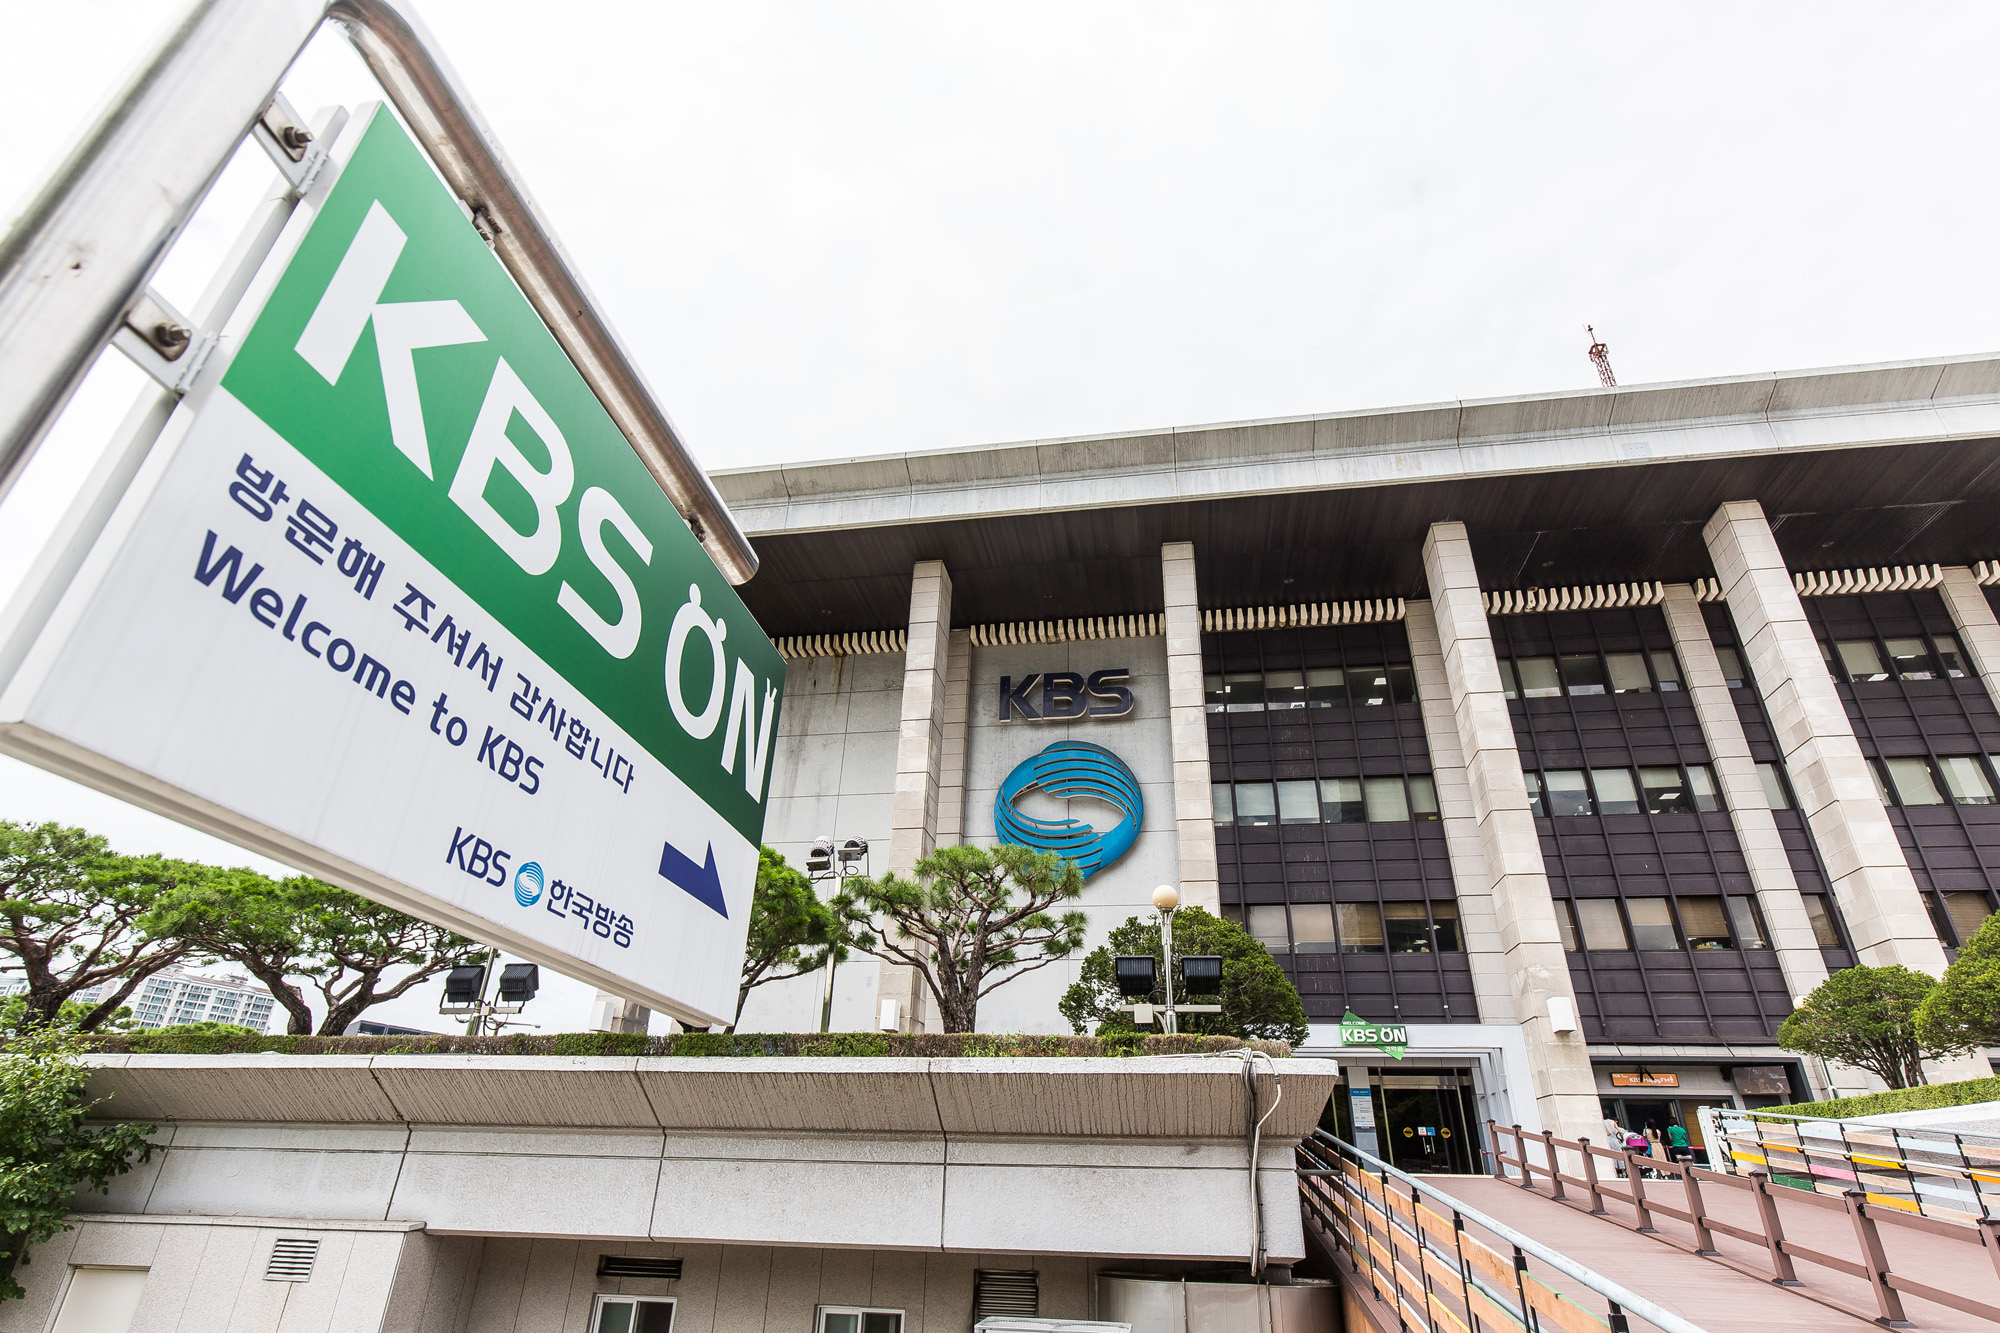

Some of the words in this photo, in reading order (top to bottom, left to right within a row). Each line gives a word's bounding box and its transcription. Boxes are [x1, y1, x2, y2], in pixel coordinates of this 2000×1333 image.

[293, 197, 654, 660] KBS
[664, 582, 778, 804] ON
[194, 529, 416, 716] Welcome
[430, 692, 468, 747] to
[477, 725, 545, 795] KBS
[229, 453, 386, 601] 방문해
[394, 582, 504, 693] 주셔서
[510, 672, 635, 795] 감사합니다
[999, 668, 1135, 723] KBS
[446, 826, 512, 888] KBS
[546, 879, 635, 949] 한국방송
[1341, 1028, 1378, 1042] KBS
[1380, 1027, 1407, 1042] ON
